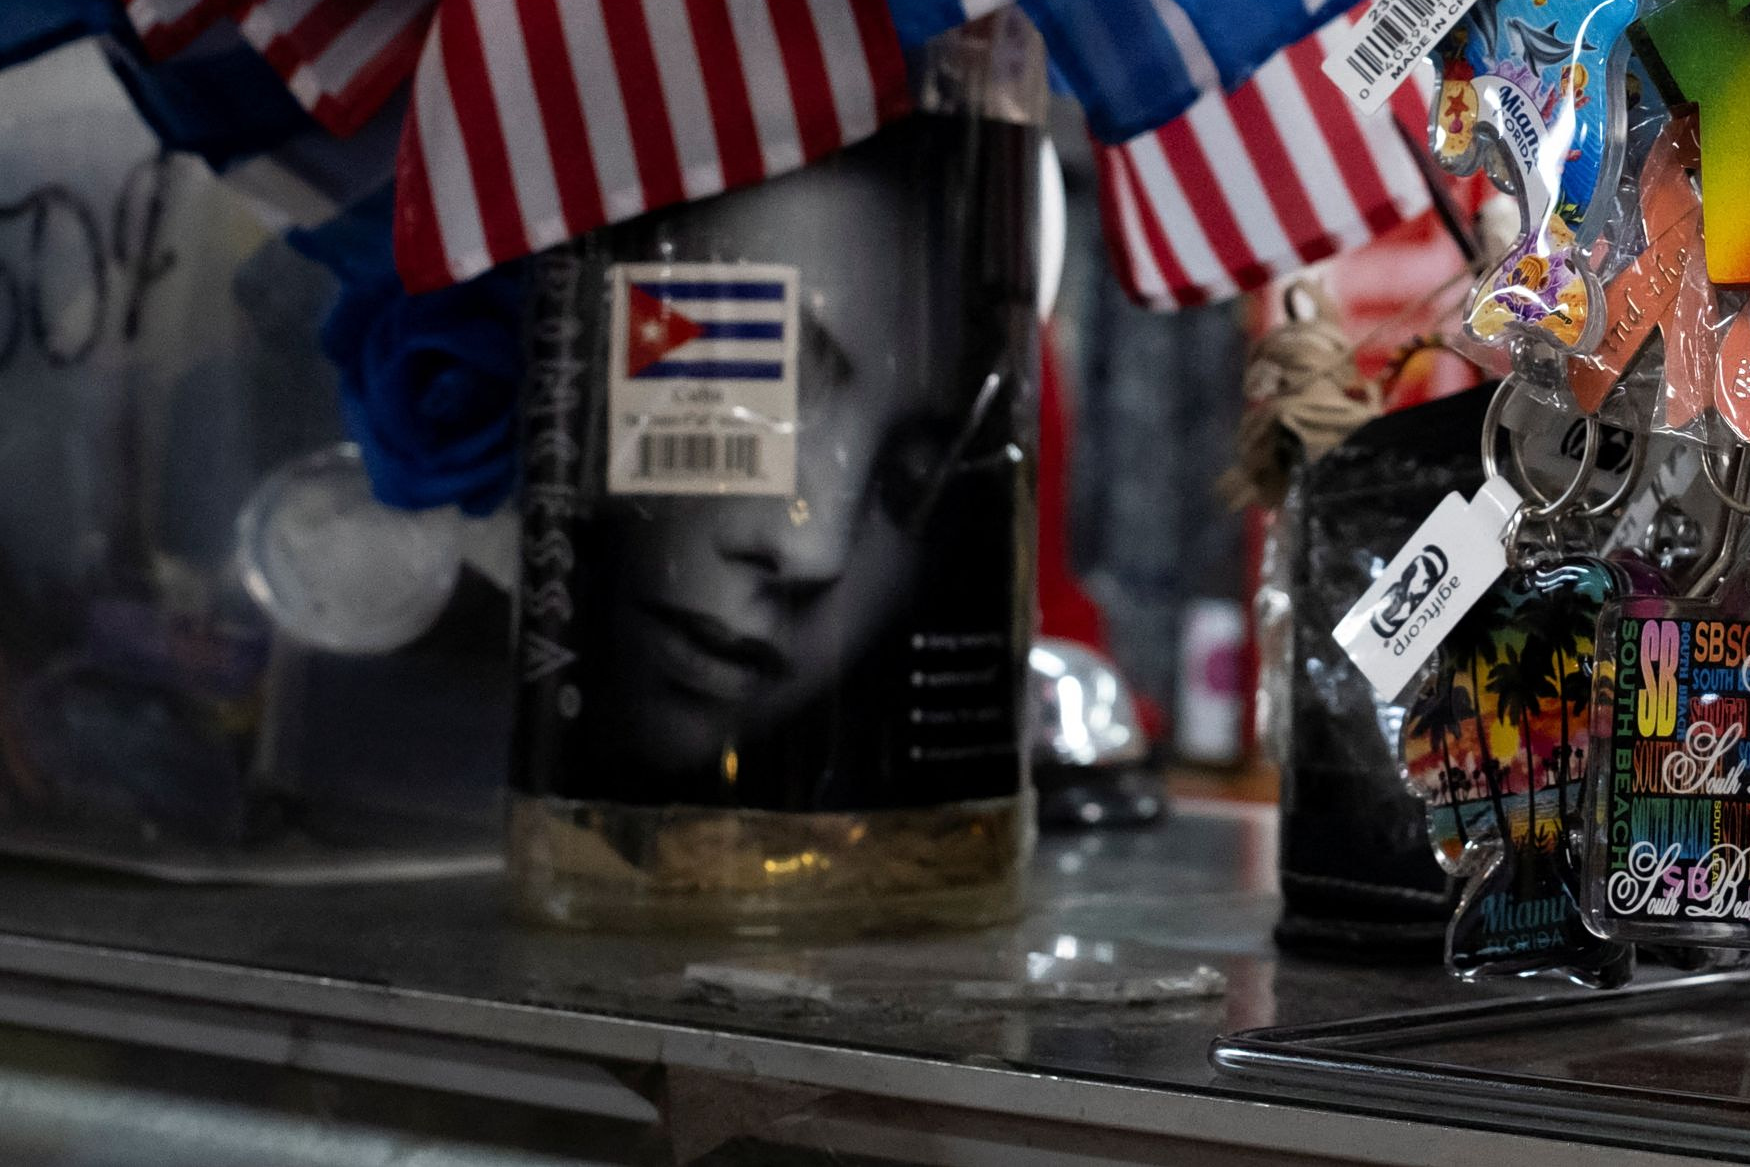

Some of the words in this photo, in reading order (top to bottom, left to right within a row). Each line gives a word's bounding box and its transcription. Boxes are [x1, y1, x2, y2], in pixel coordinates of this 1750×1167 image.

[1385, 18, 1430, 71] 40399
[1390, 38, 1431, 80] MADE
[1431, 18, 1447, 35] IN
[1393, 575, 1462, 656] agiftcorp
[1679, 621, 1692, 679] SOUTH
[1694, 621, 1725, 663] SB
[1617, 620, 1639, 737] SOUTH
[1637, 619, 1680, 737] SB
[1692, 668, 1734, 691] SOUTH
[1662, 720, 1747, 794] South
[1612, 748, 1632, 870] BEACH
[1607, 841, 1684, 915] South
